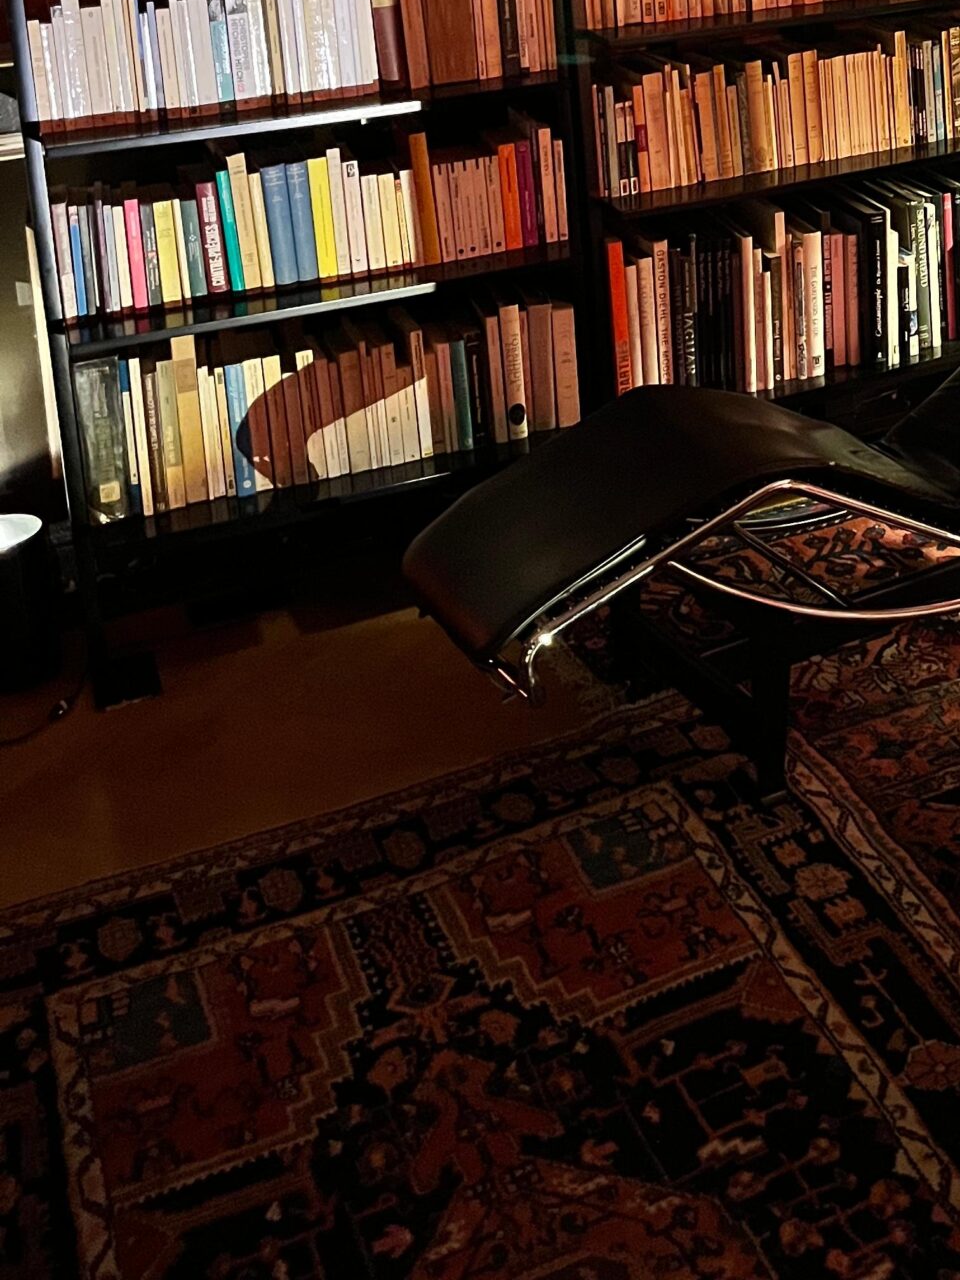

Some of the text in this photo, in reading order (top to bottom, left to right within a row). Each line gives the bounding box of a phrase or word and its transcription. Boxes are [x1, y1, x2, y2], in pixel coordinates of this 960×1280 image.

[231, 18, 243, 58] HITCHENS
[239, 17, 251, 71] CHRISTOPHER
[916, 209, 929, 288] SIGMUND FREUD
[656, 249, 668, 289] GASTON
[659, 293, 669, 321] DIEHL
[661, 328, 669, 345] THE
[683, 312, 696, 375] JAGUAR
